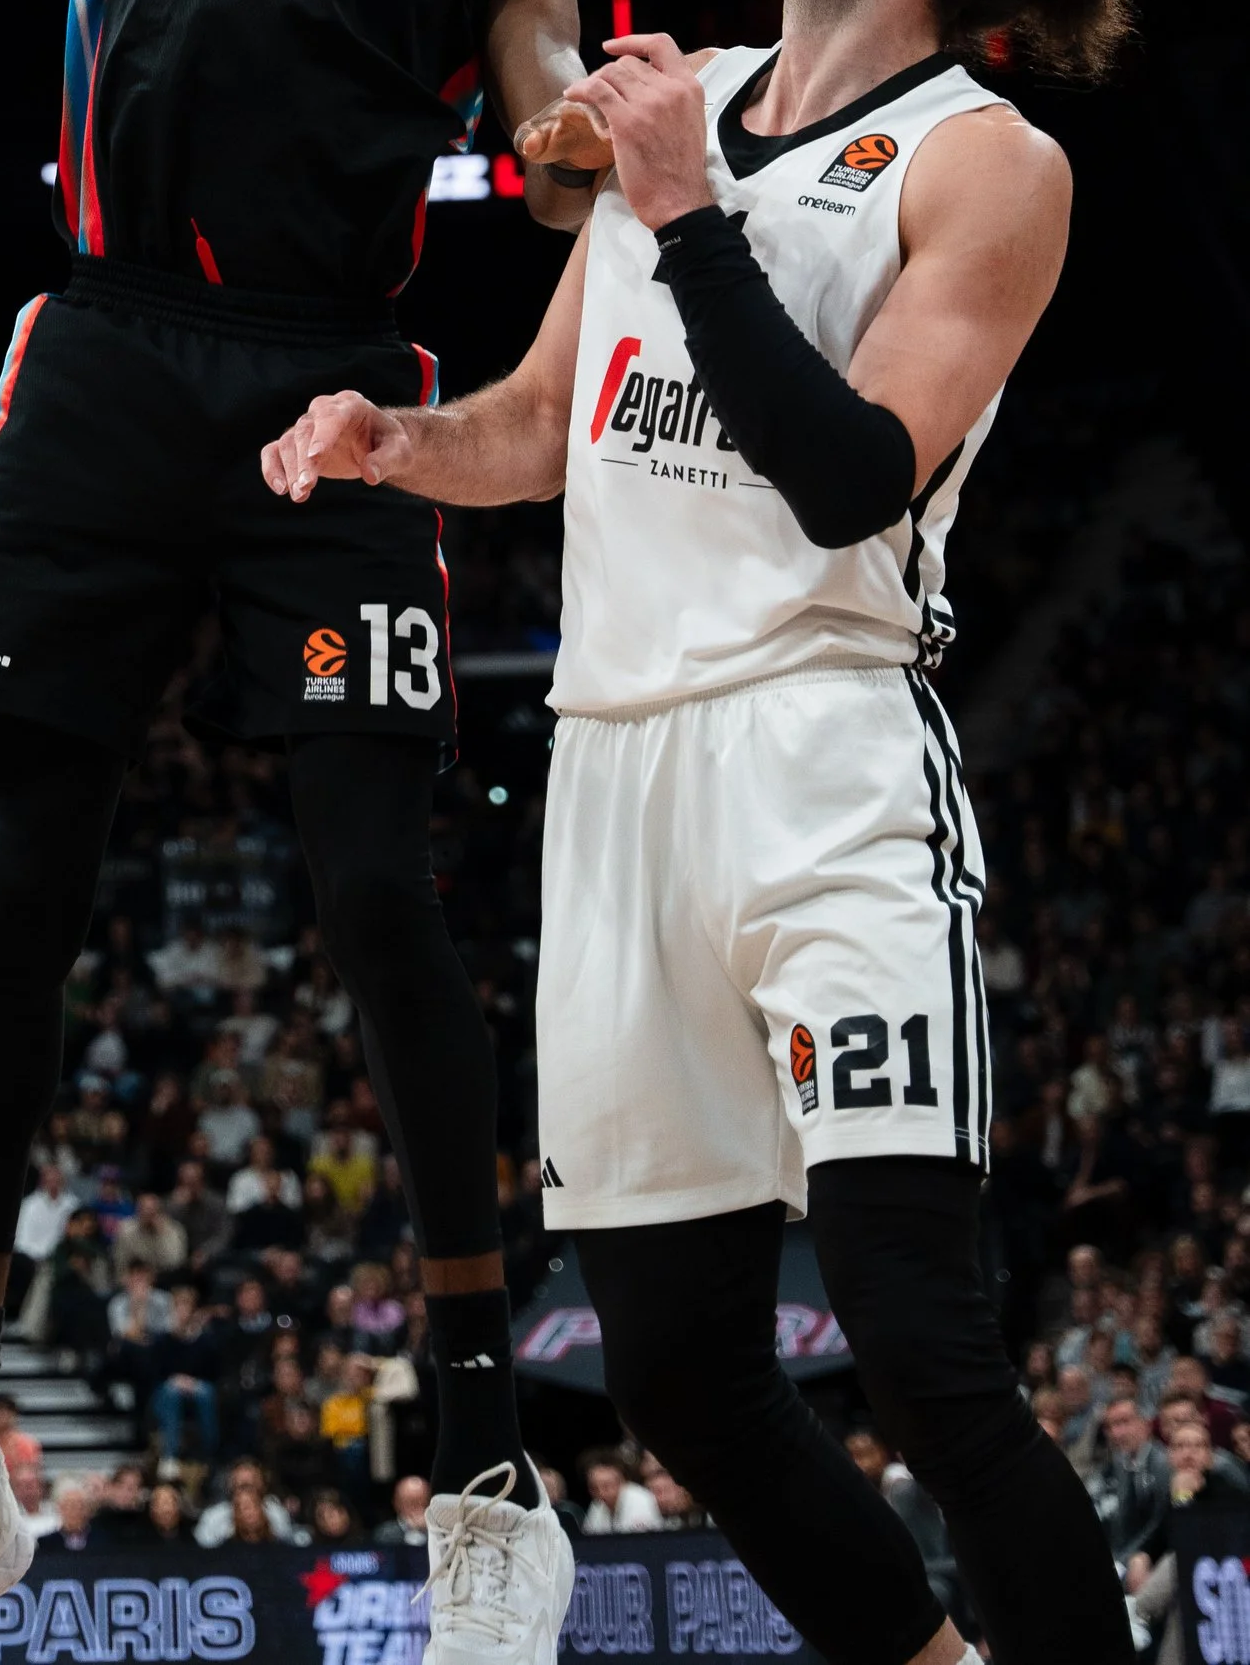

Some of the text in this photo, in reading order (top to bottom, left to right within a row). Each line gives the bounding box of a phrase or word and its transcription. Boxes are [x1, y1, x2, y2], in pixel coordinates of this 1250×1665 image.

[827, 170, 869, 186] AIRLINES
[833, 164, 874, 180] TURKISH
[797, 195, 857, 216] oneteam
[650, 459, 728, 490] ZANETTI
[360, 603, 442, 711] 13
[305, 676, 345, 686] TURKISH
[305, 685, 345, 694] AIRLINES
[830, 1013, 939, 1111] 21
[556, 1561, 655, 1655] OUR
